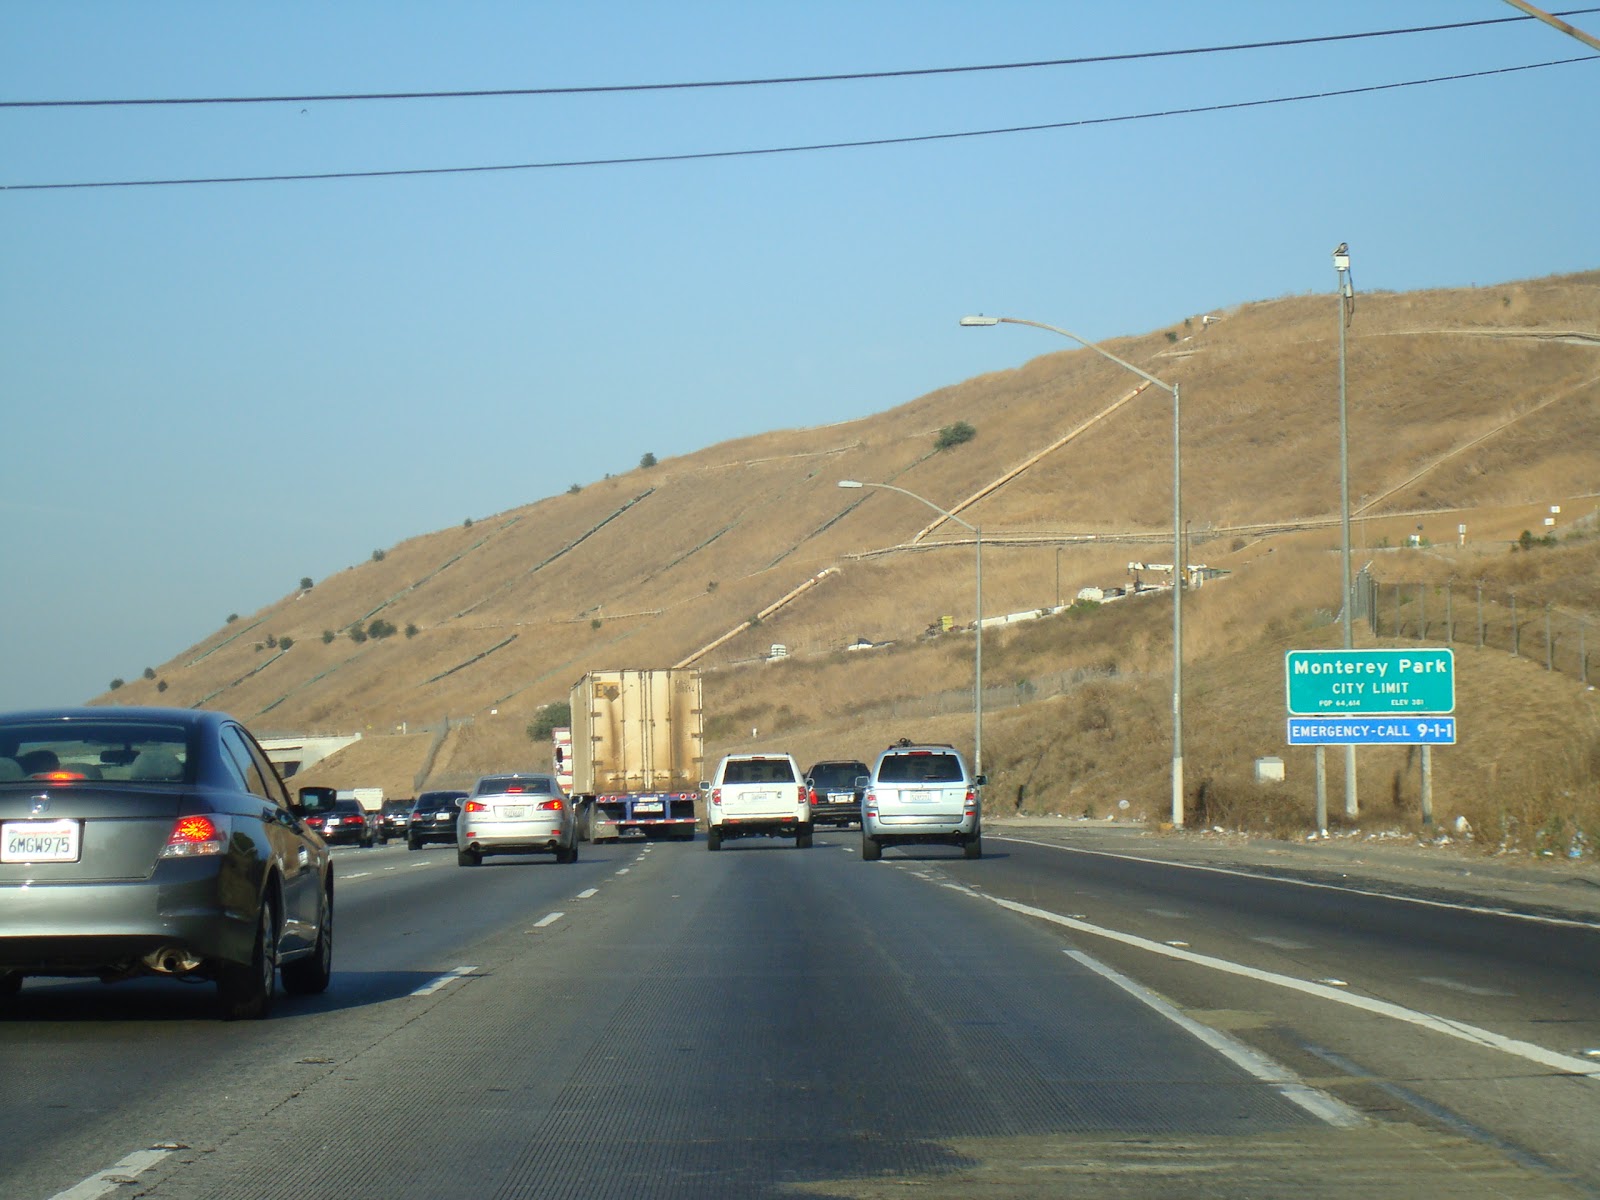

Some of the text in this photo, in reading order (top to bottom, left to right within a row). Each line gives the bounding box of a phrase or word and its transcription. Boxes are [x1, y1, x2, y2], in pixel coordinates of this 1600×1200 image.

[1294, 659, 1447, 677] Monterey Park
[1332, 682, 1409, 694] CITY LIMIT
[1319, 699, 1333, 707] POP
[1292, 724, 1452, 738] EMERGENCY-CALL 9-1-1
[8, 837, 70, 854] 6MGW975
